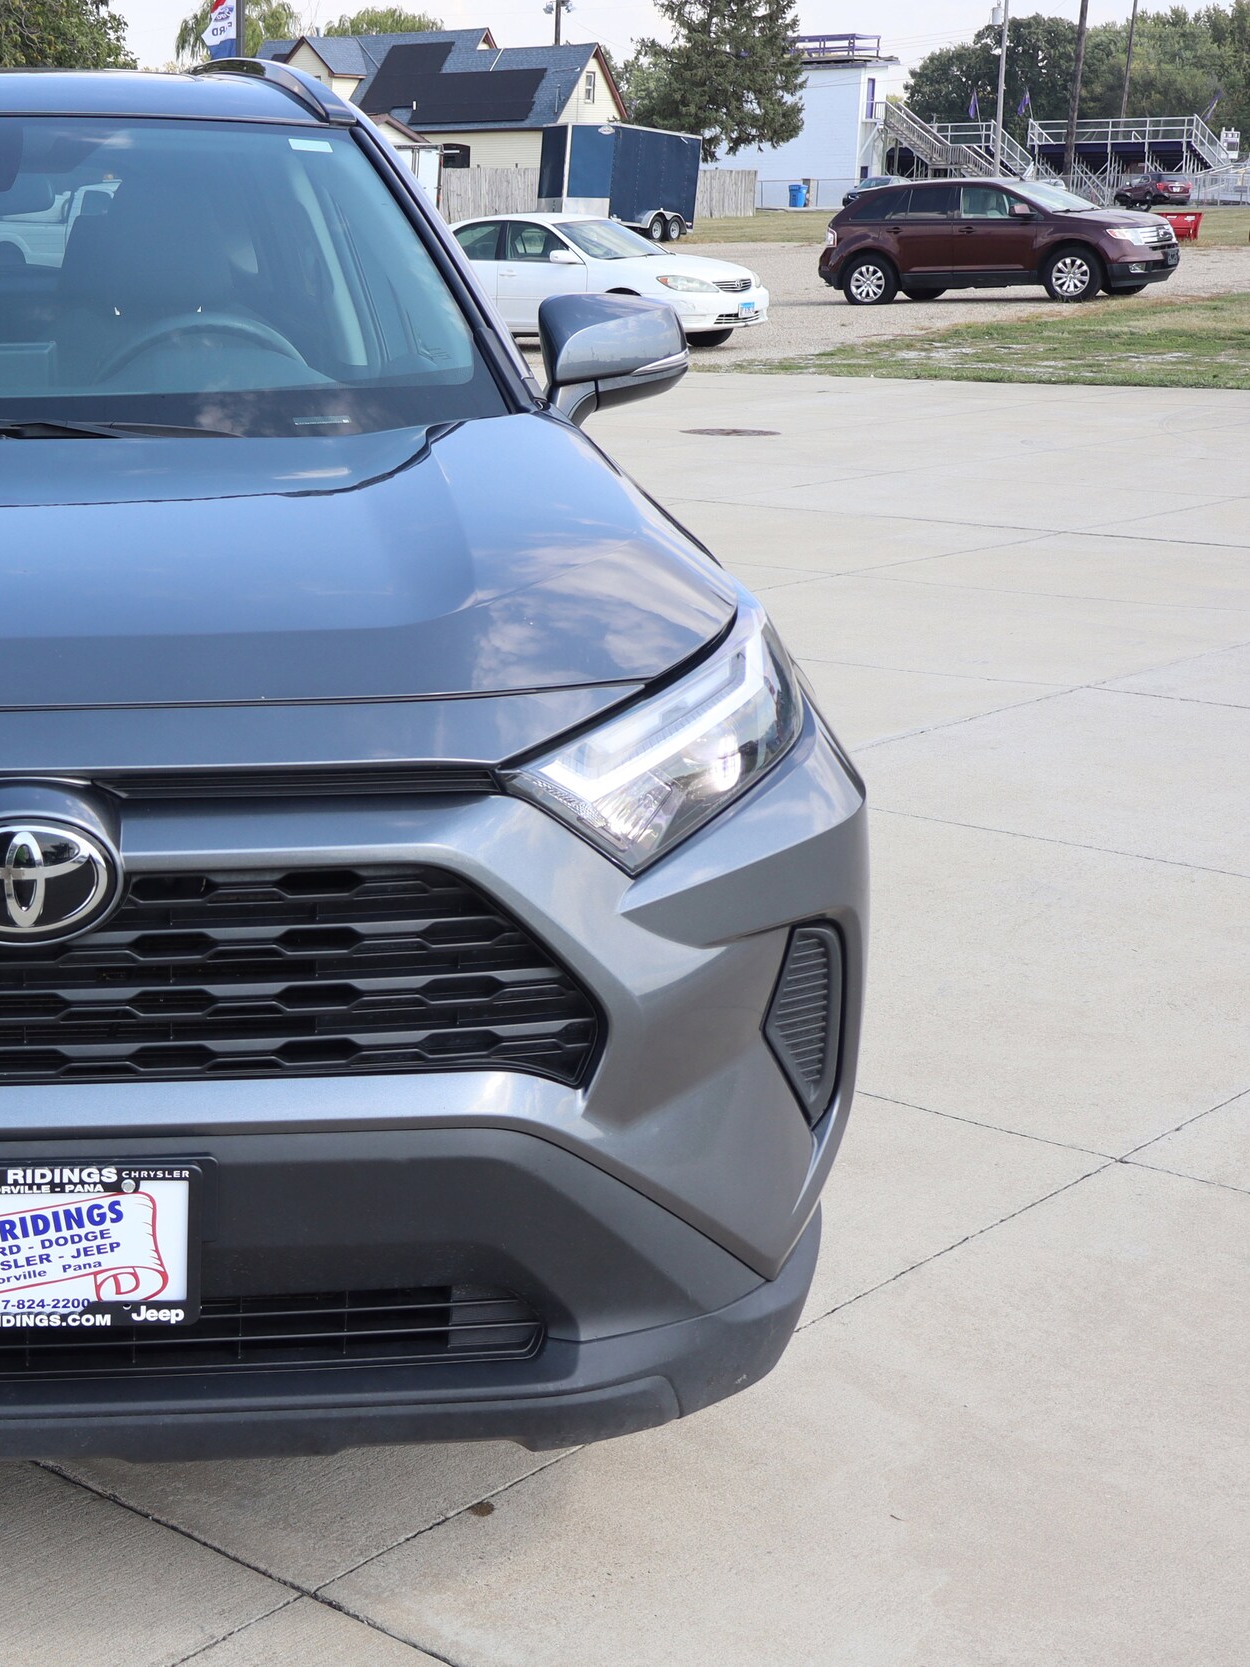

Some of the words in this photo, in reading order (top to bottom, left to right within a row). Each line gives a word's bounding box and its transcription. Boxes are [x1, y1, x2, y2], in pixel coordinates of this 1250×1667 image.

[7, 1167, 118, 1185] RIDINGS
[121, 1169, 190, 1179] CHRYSLER
[64, 1184, 105, 1193] PANA
[40, 1228, 112, 1250] DODGE
[70, 1241, 121, 1259] JEEP
[61, 1260, 102, 1273] Pana
[131, 1305, 185, 1324] Jeep
